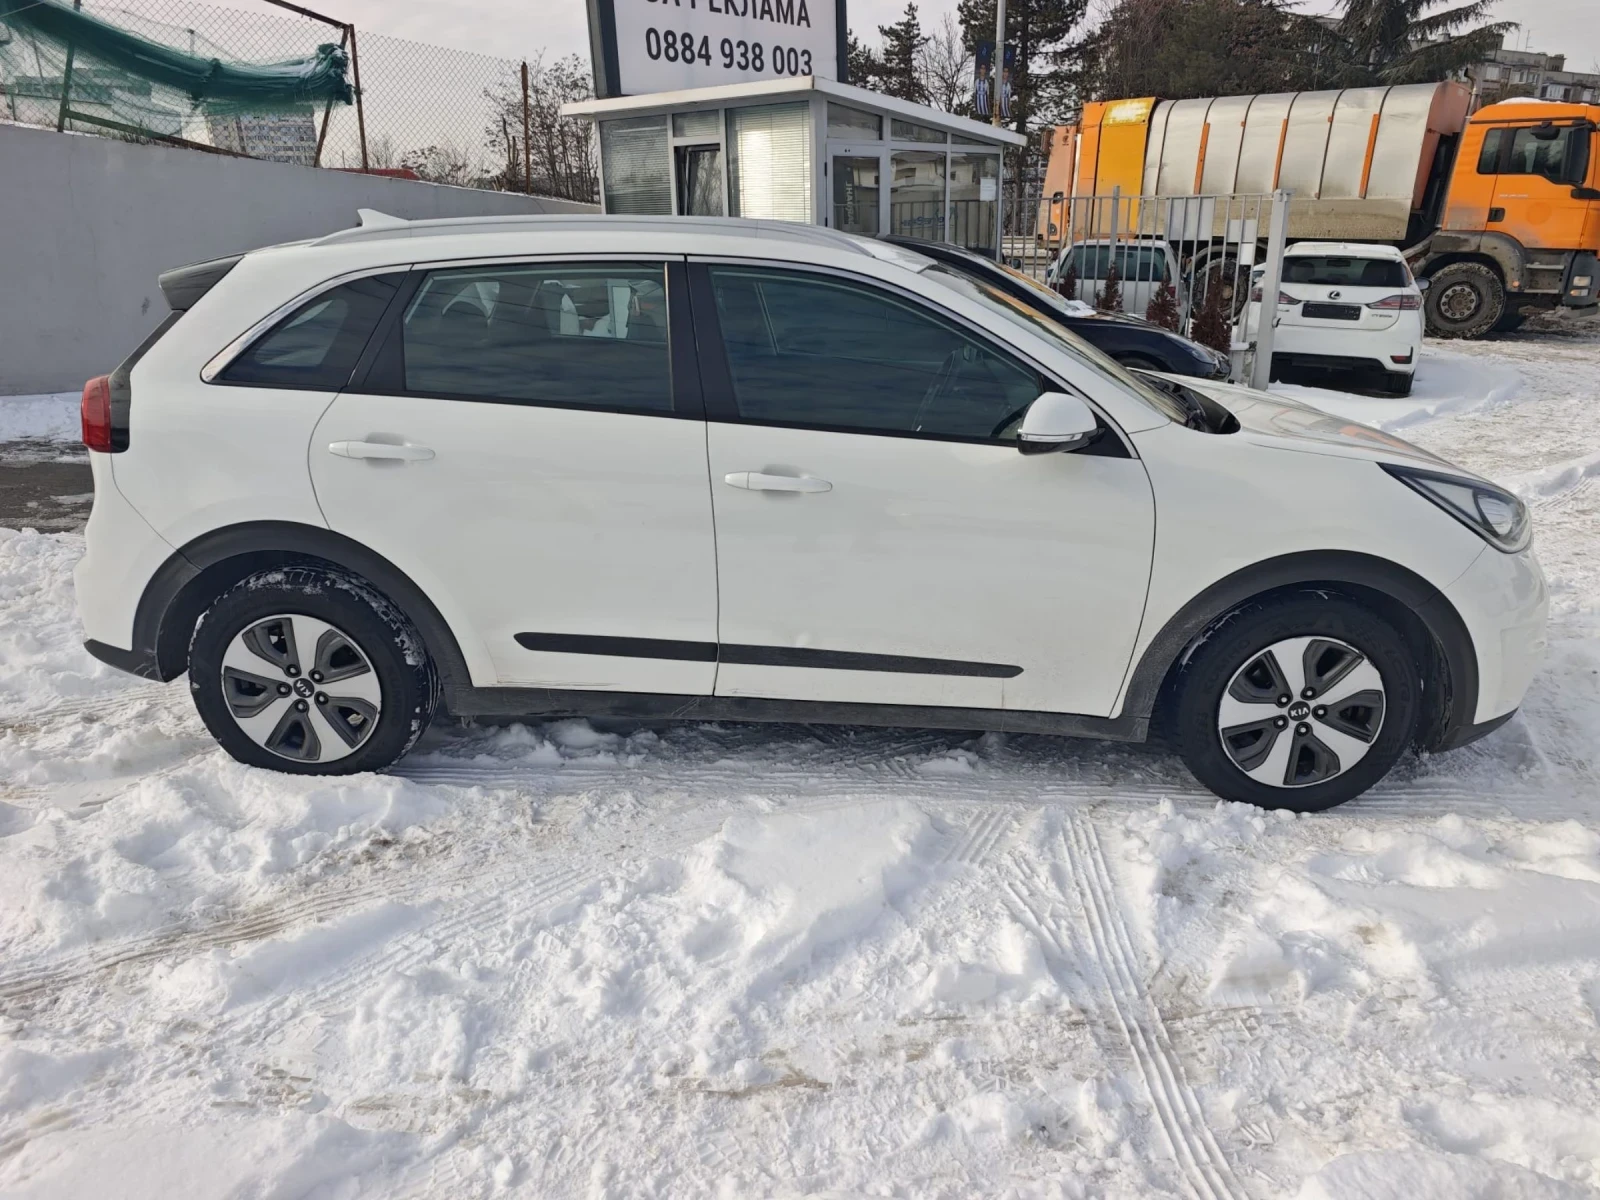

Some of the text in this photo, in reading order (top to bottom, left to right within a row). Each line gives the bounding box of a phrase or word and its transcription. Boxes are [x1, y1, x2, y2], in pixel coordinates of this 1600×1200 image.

[690, 0, 811, 28] КЛАМА
[645, 27, 812, 76] 0884 938 003
[296, 680, 311, 697] KIA
[1290, 707, 1309, 717] KIA
